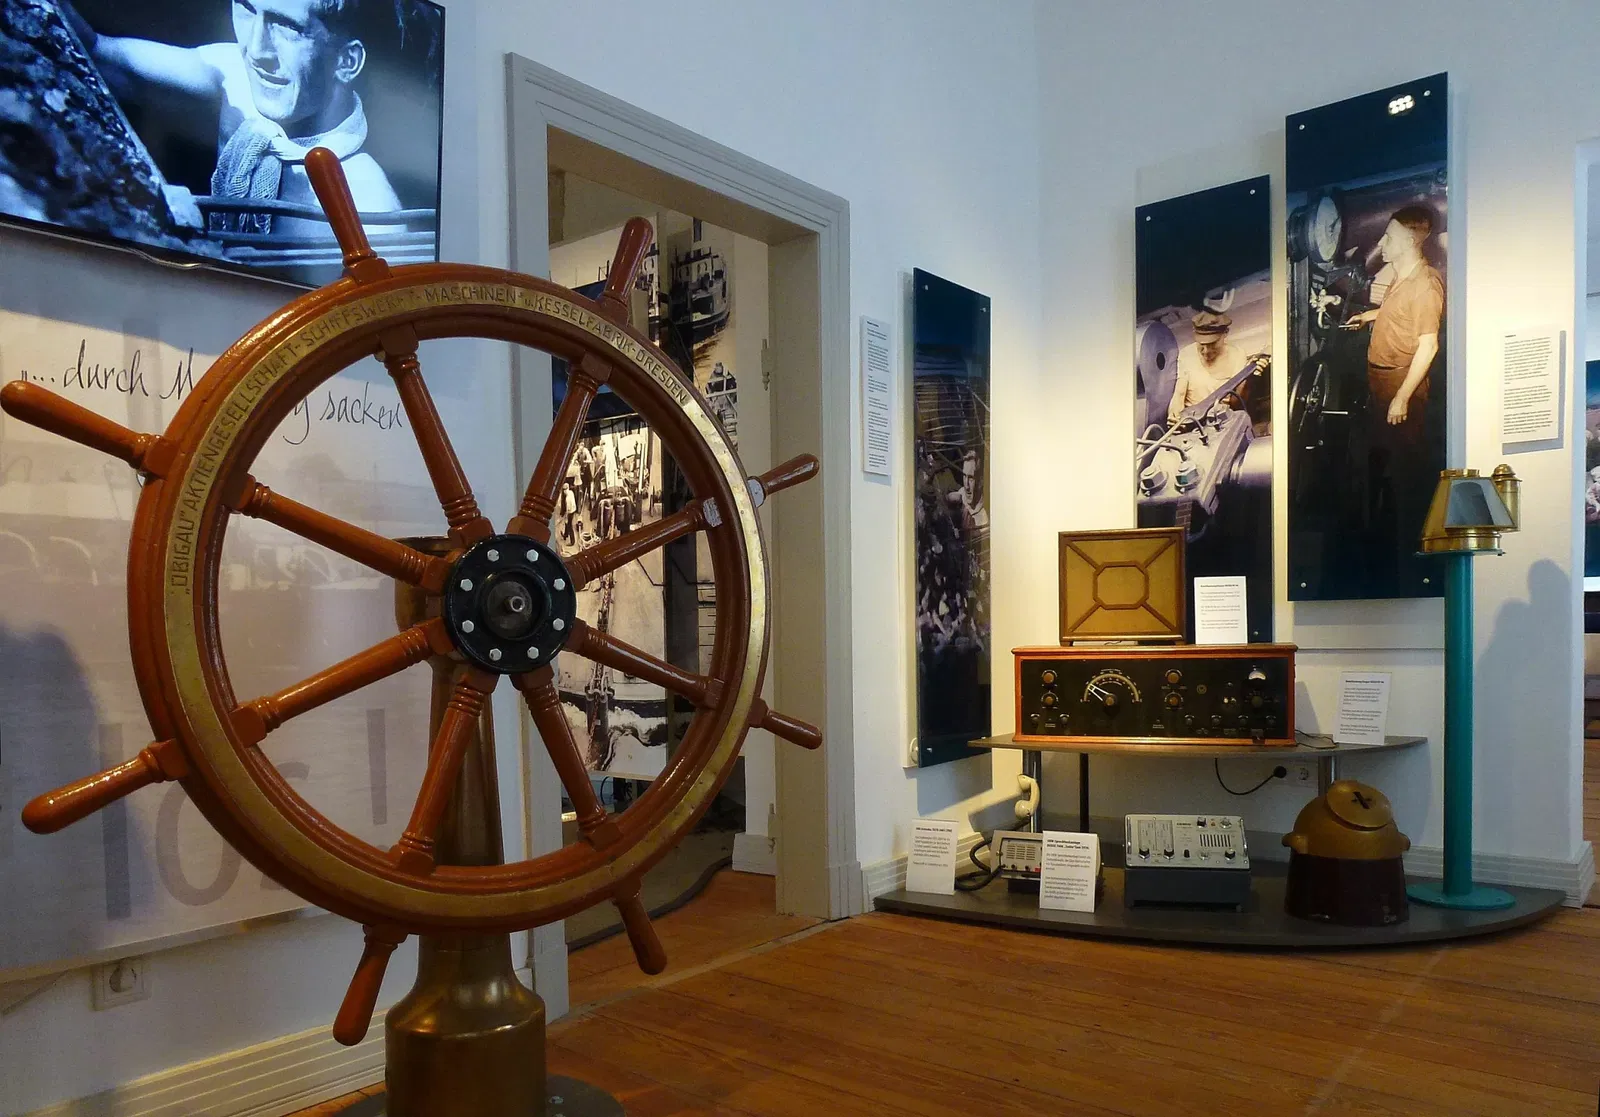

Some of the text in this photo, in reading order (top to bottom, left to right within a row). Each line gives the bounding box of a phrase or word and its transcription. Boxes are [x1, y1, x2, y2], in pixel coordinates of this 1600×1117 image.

[63, 339, 149, 397] durch
[319, 381, 403, 430] sacken
[634, 346, 692, 403] DRESDEN
